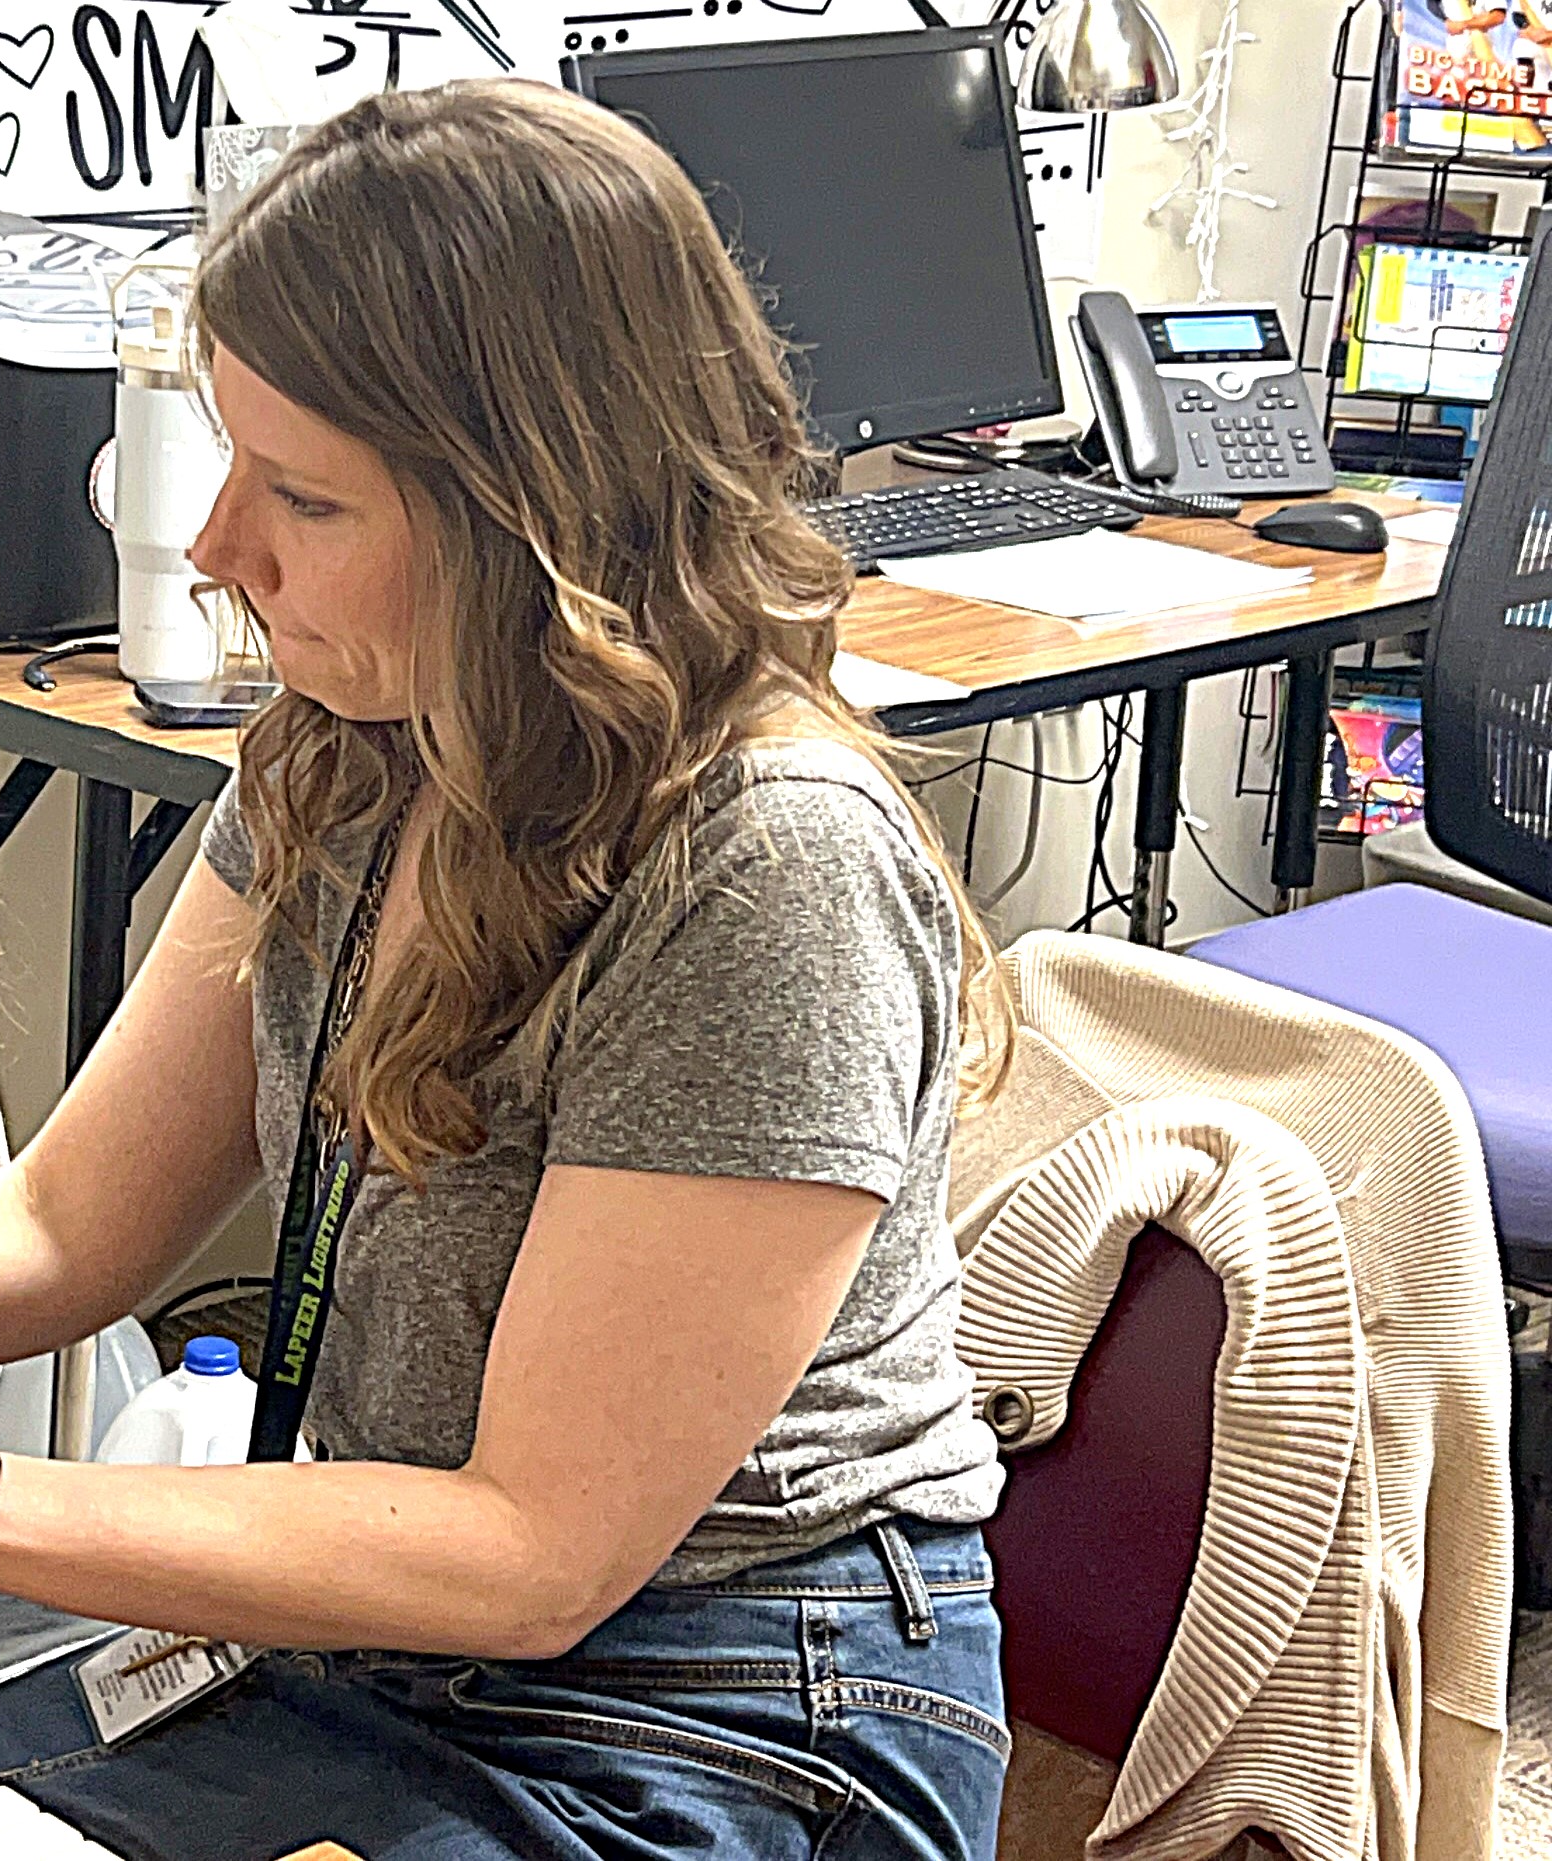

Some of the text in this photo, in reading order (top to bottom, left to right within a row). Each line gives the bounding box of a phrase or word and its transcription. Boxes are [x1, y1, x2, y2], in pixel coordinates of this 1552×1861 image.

[1408, 66, 1552, 116] BASHE
[274, 1292, 321, 1386] LAPEER
[302, 1159, 349, 1292] LIGHTNING
